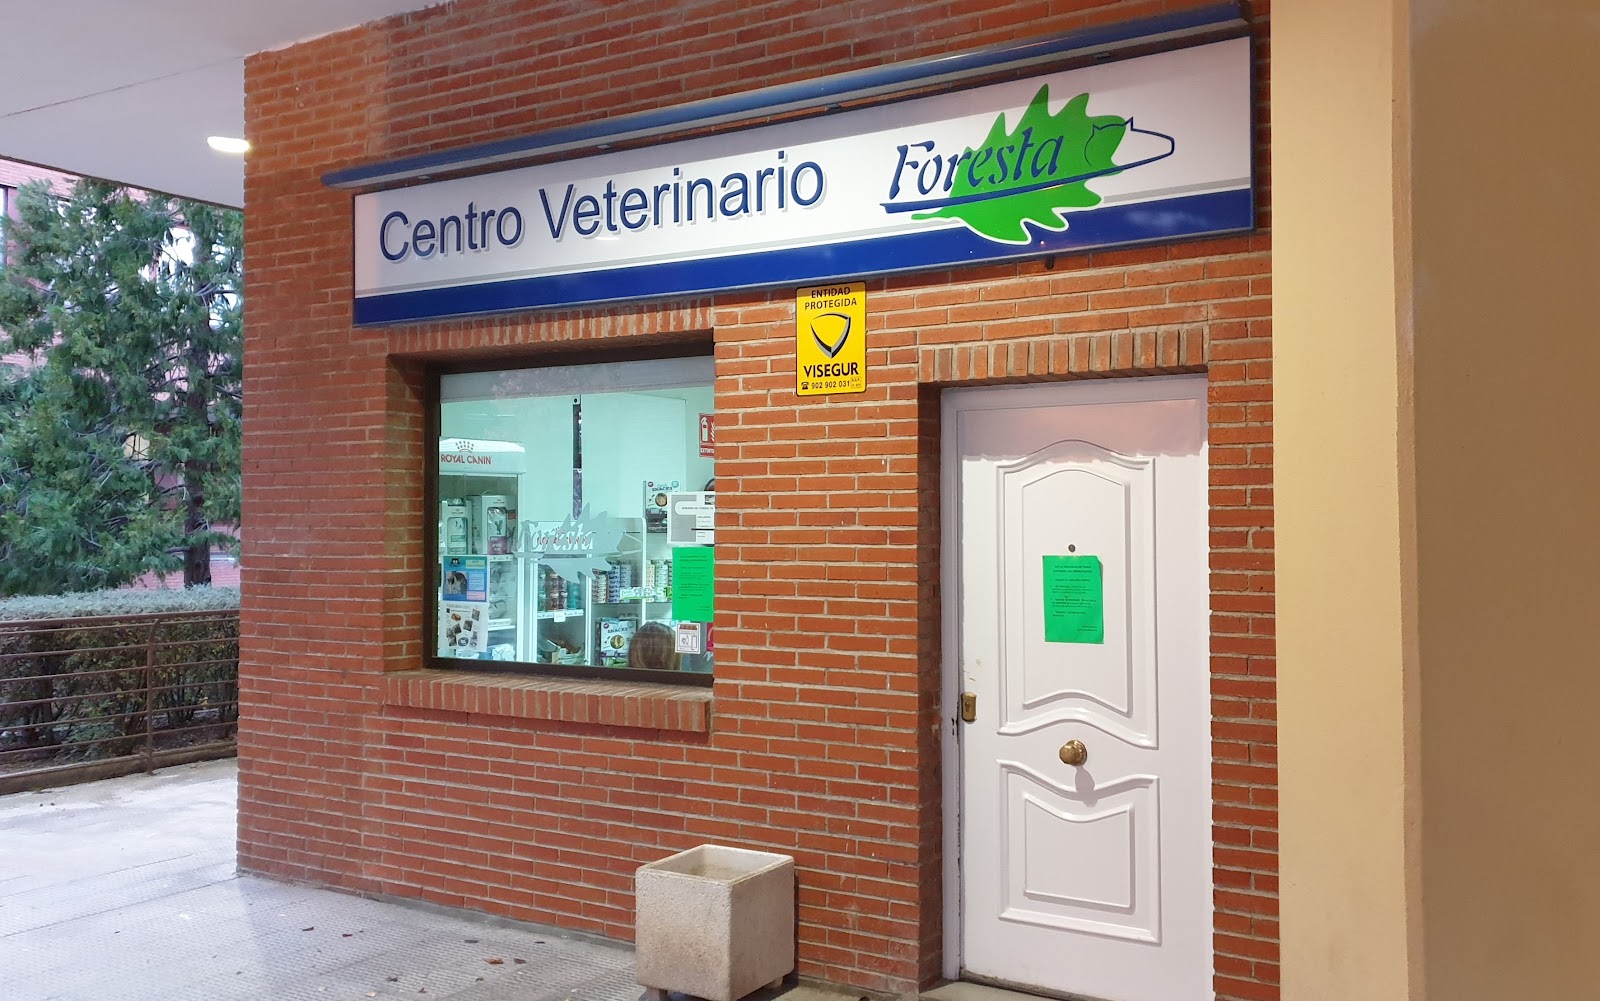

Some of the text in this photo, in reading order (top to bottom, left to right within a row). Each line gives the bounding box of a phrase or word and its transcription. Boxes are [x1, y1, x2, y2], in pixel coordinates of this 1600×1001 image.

[888, 126, 1065, 201] Foresta
[380, 151, 825, 262] Centro Veterinario
[811, 286, 851, 299] ENTIDAD
[804, 297, 858, 311] PROTEGIDA
[803, 362, 859, 378] VISEGUR
[811, 381, 824, 389] 902
[825, 380, 837, 388] 902
[838, 380, 851, 388] 031
[440, 454, 492, 465] ROYAL CANIN
